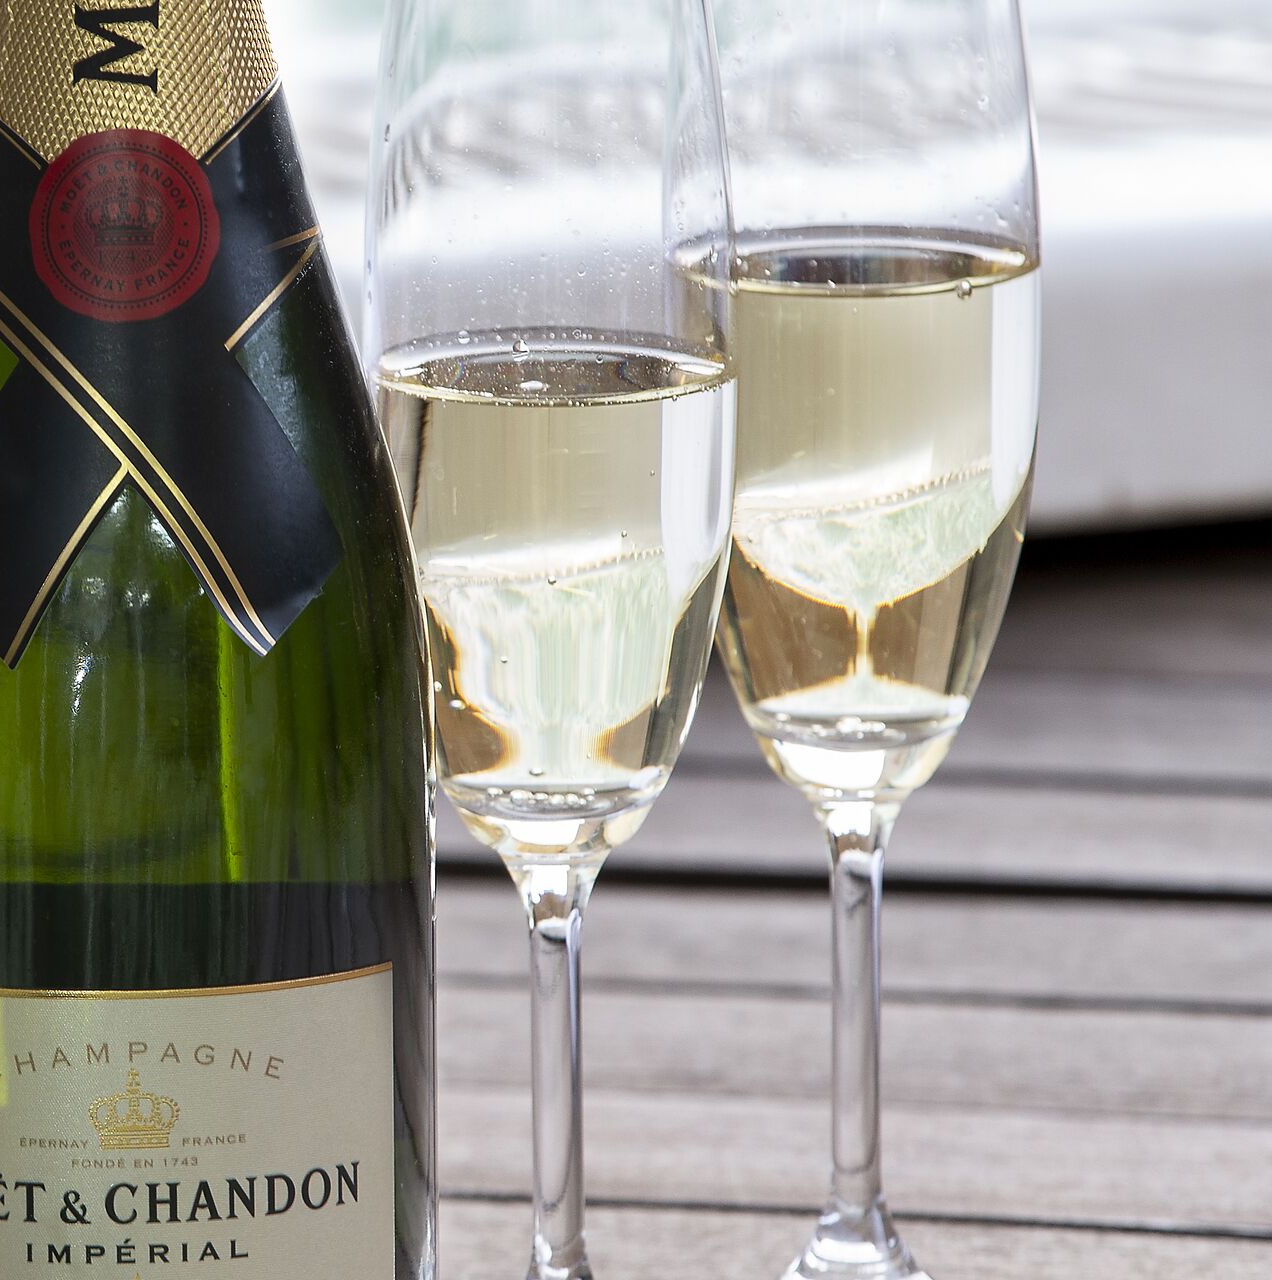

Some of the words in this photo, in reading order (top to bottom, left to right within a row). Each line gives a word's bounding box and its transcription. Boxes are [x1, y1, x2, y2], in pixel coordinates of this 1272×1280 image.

[97, 164, 108, 176] &
[114, 159, 189, 210] CHANDON
[134, 237, 190, 291] FRANCE
[182, 1133, 247, 1147] FRANCE
[134, 1158, 154, 1168] EN
[164, 1156, 199, 1167] 1743
[59, 1188, 92, 1225] &
[104, 1160, 361, 1226] CHANDON
[26, 1237, 249, 1266] IMPÉRIAL
